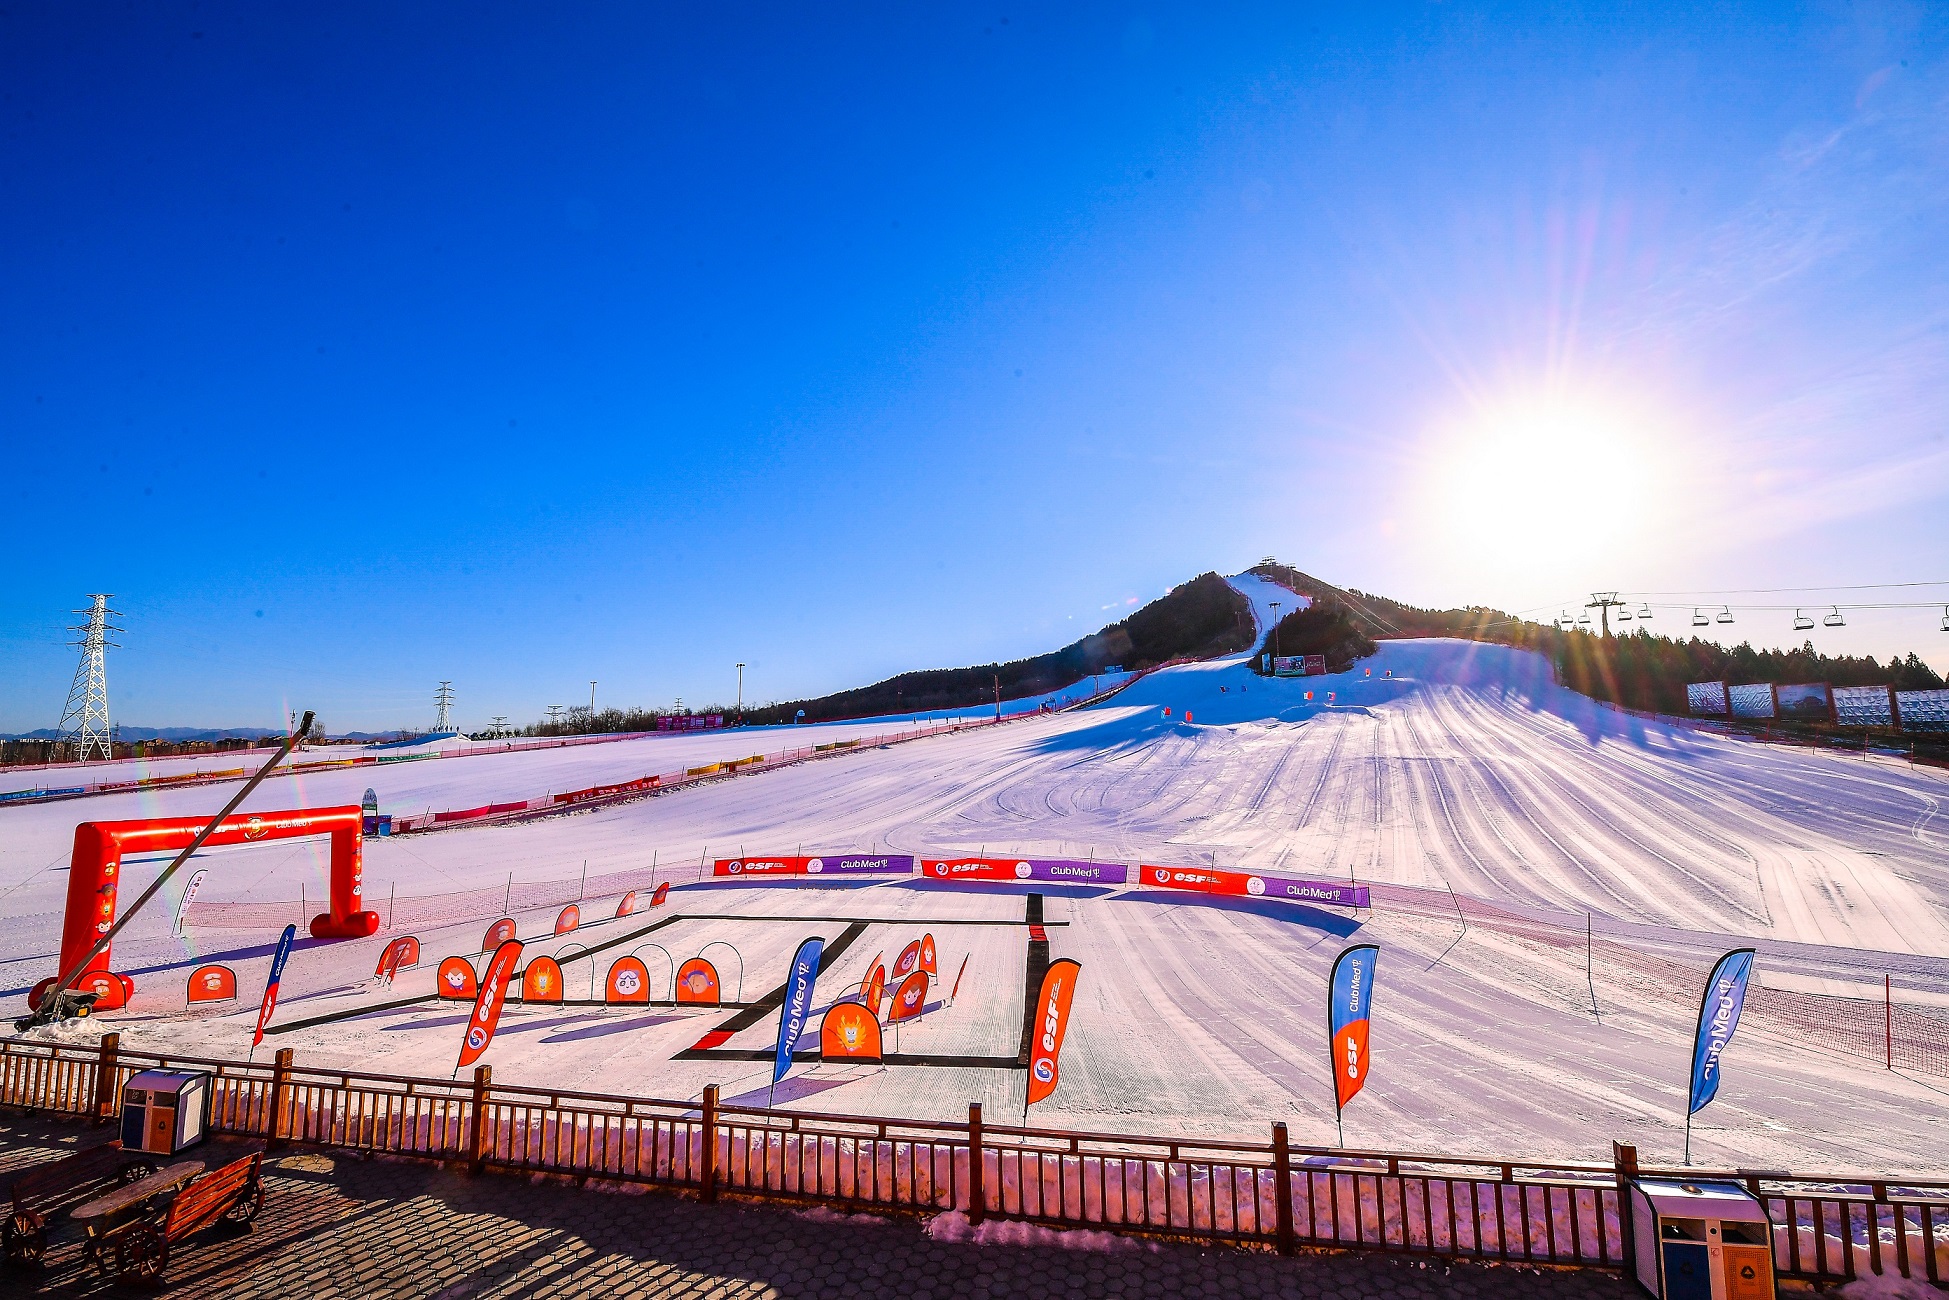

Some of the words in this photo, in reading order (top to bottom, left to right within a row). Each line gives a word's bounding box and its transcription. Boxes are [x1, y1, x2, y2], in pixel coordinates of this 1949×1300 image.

[840, 860, 860, 869] Club
[860, 859, 880, 868] Med
[1051, 866, 1071, 875] Club
[1072, 867, 1091, 877] Med
[1286, 885, 1310, 896] Club
[1310, 887, 1332, 899] Med
[1350, 967, 1362, 990] Med
[791, 977, 807, 1017] Med
[1349, 989, 1360, 1012] Club
[1710, 996, 1734, 1038] Med
